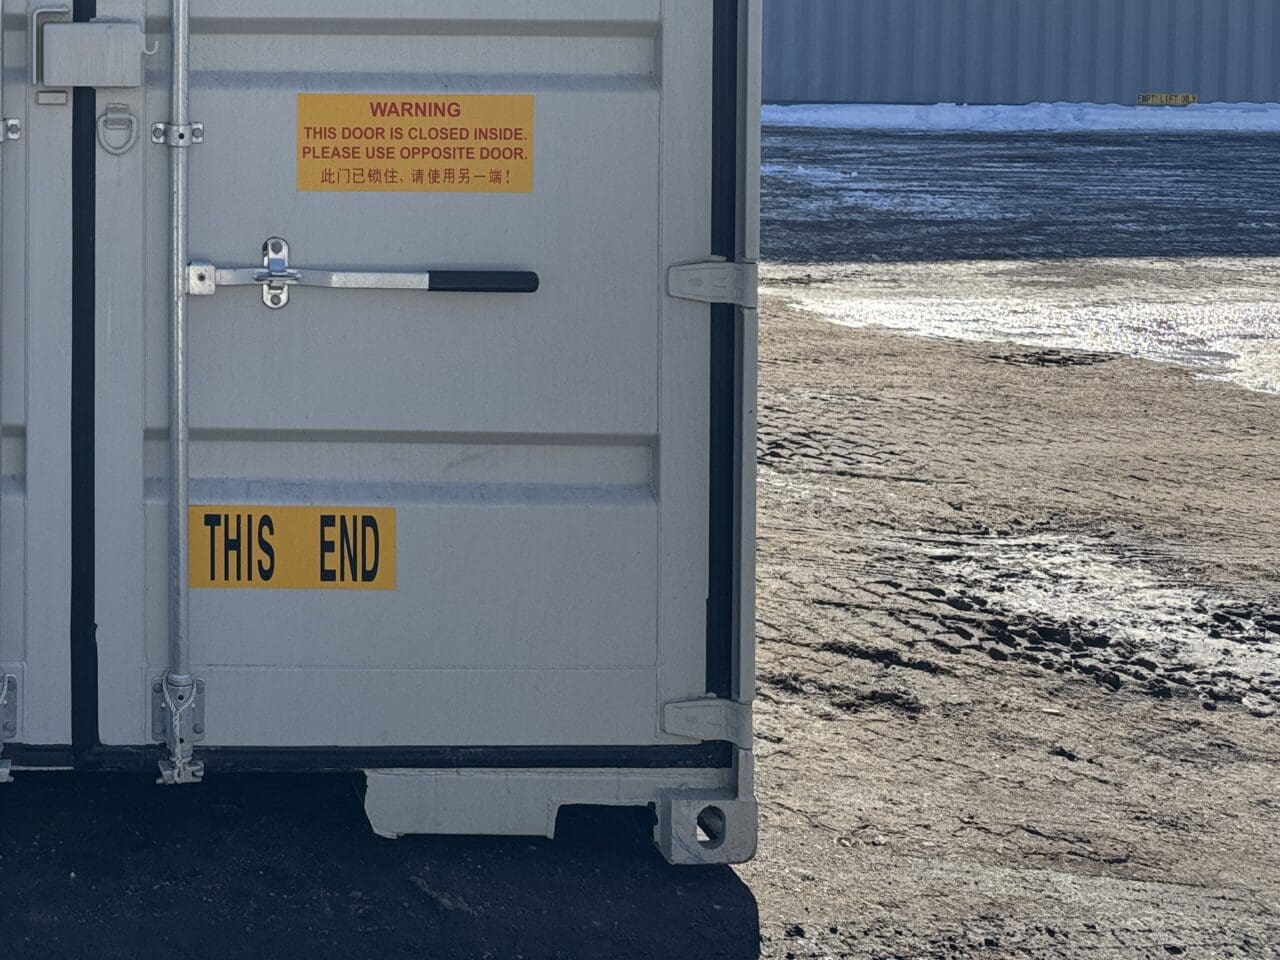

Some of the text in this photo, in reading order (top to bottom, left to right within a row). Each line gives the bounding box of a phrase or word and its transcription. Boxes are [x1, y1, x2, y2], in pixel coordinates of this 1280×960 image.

[370, 102, 461, 118] WARNING
[304, 126, 527, 141] THIS DOOR IS CLOSED INSIDE.
[302, 146, 527, 160] PLEASE USE OPPOSITE DOOR.
[204, 514, 380, 582] THIS END
